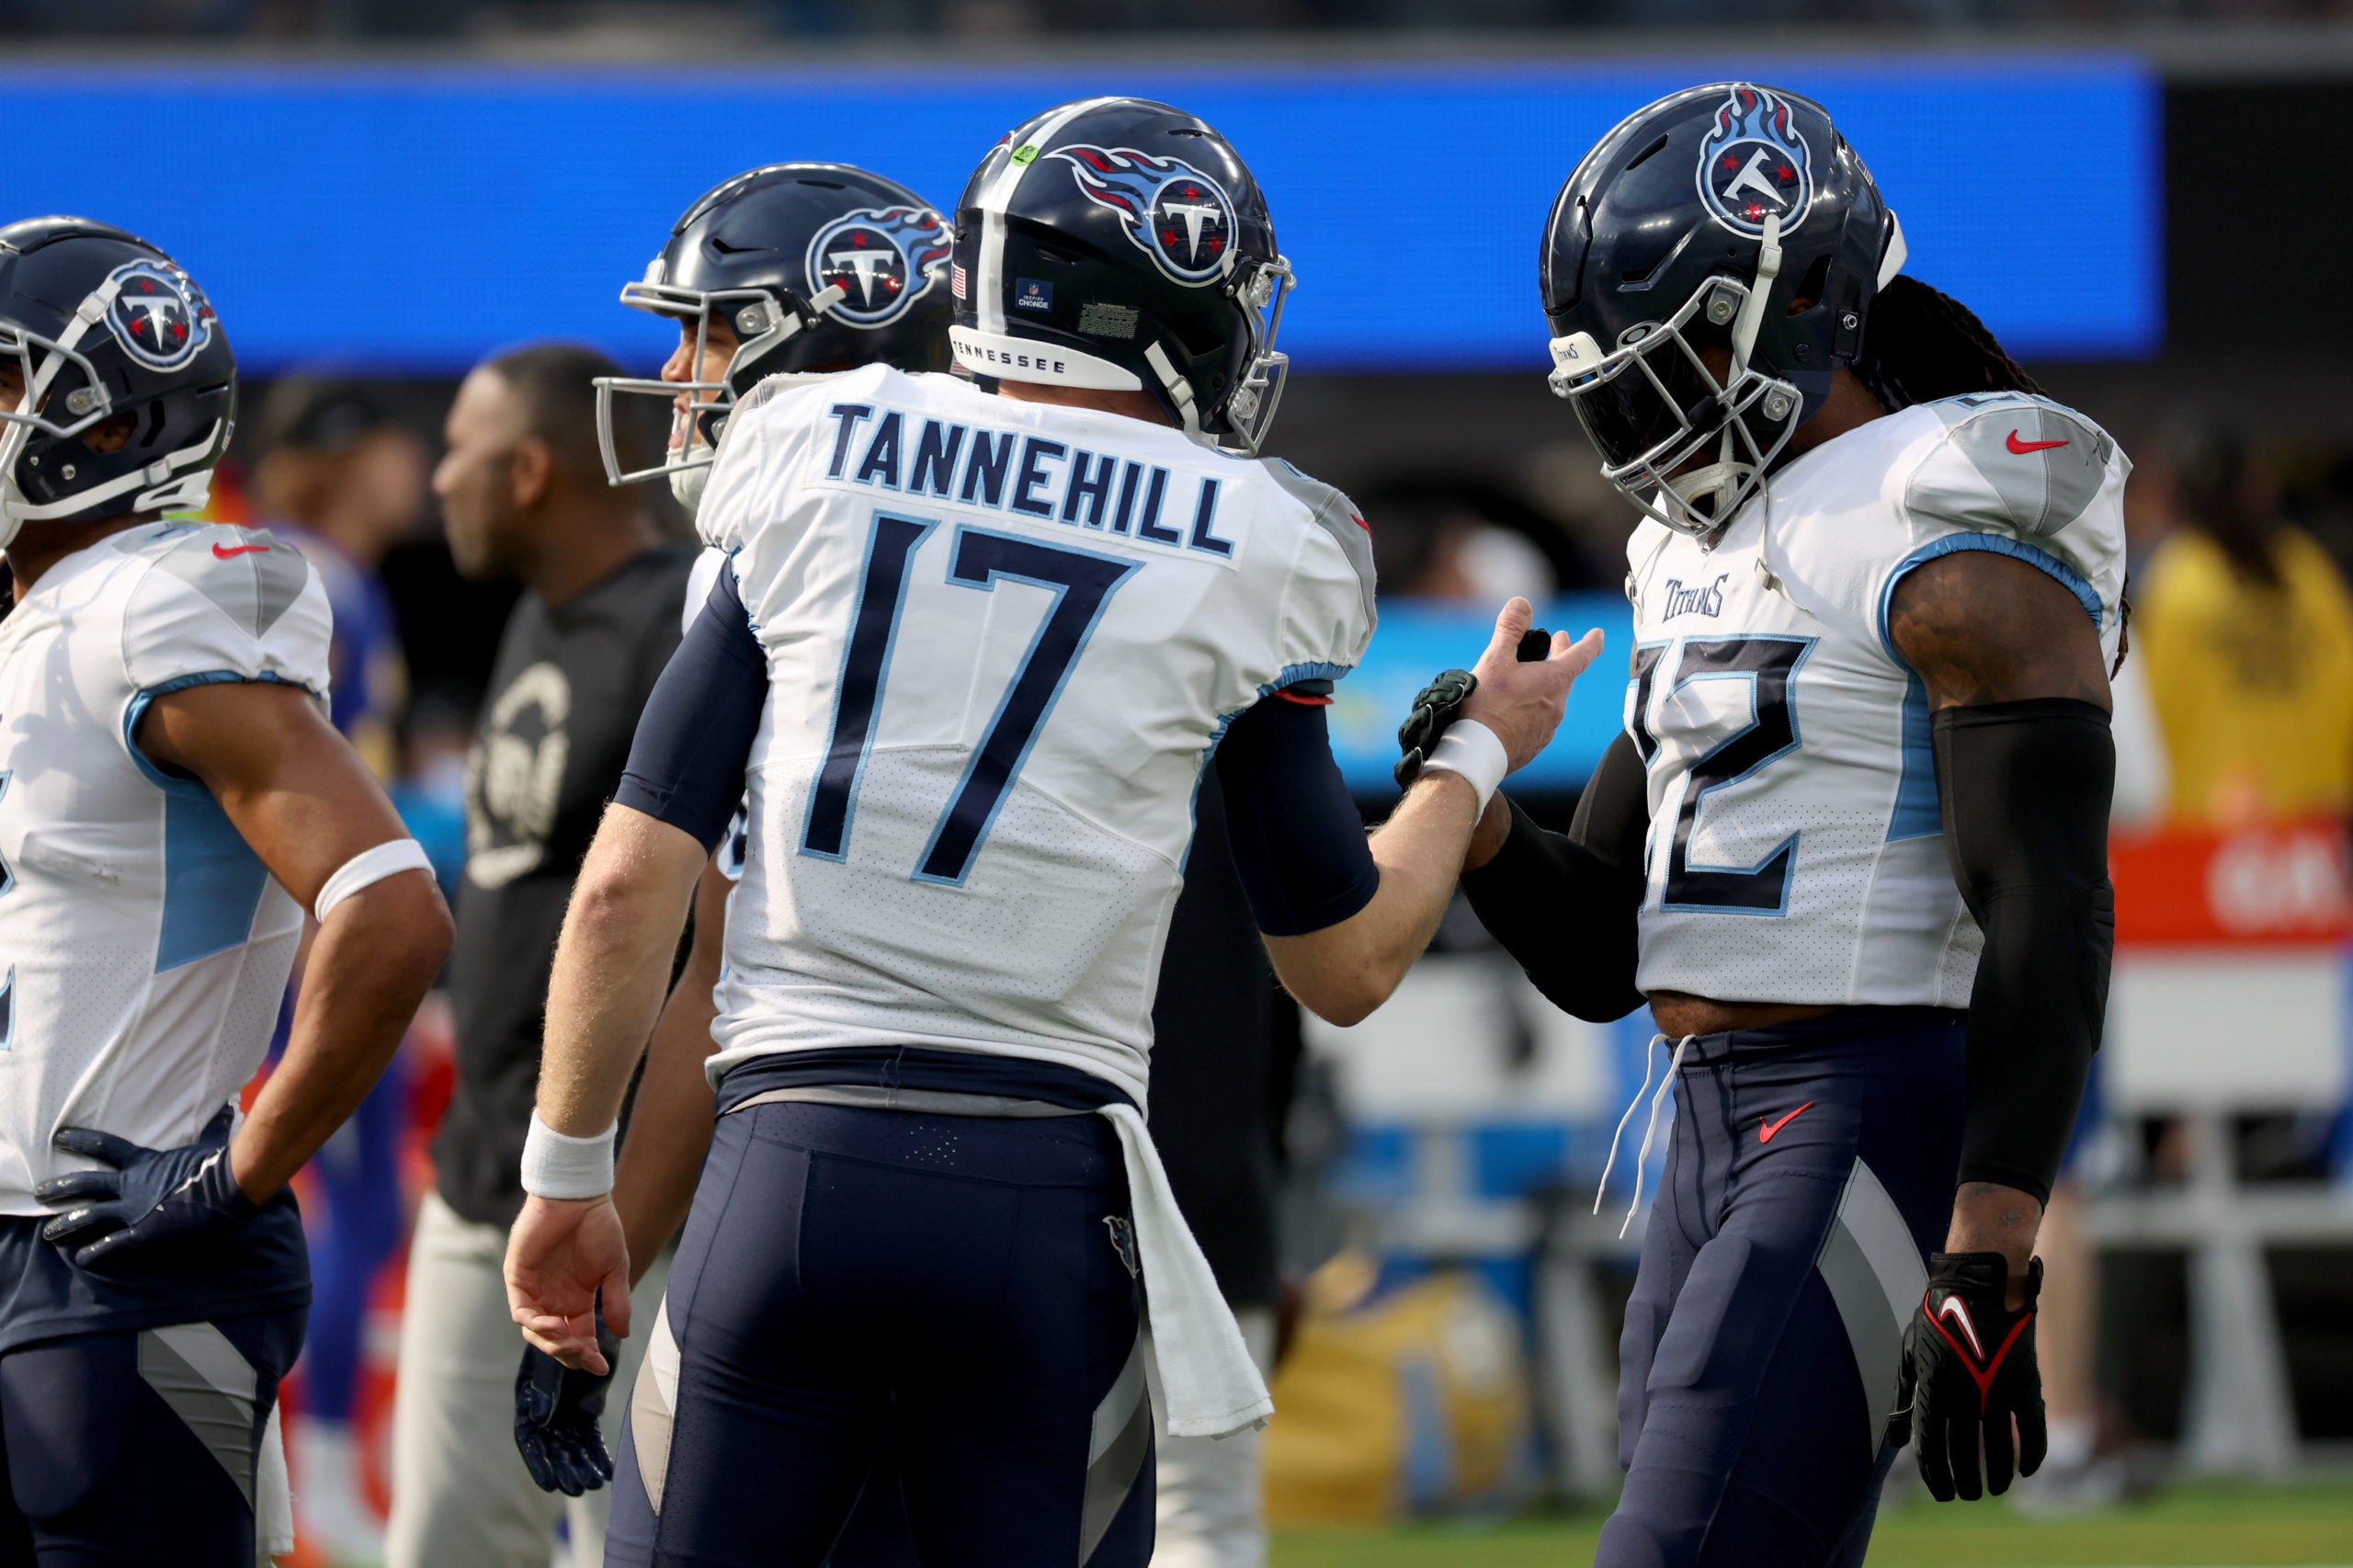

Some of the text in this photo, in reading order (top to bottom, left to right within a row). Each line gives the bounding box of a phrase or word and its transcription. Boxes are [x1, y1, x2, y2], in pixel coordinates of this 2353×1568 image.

[1018, 299, 1049, 309] CHANGE
[953, 340, 1065, 373] TENNESSEE
[825, 402, 1234, 559] TANNEHILL
[797, 508, 1146, 888] 17
